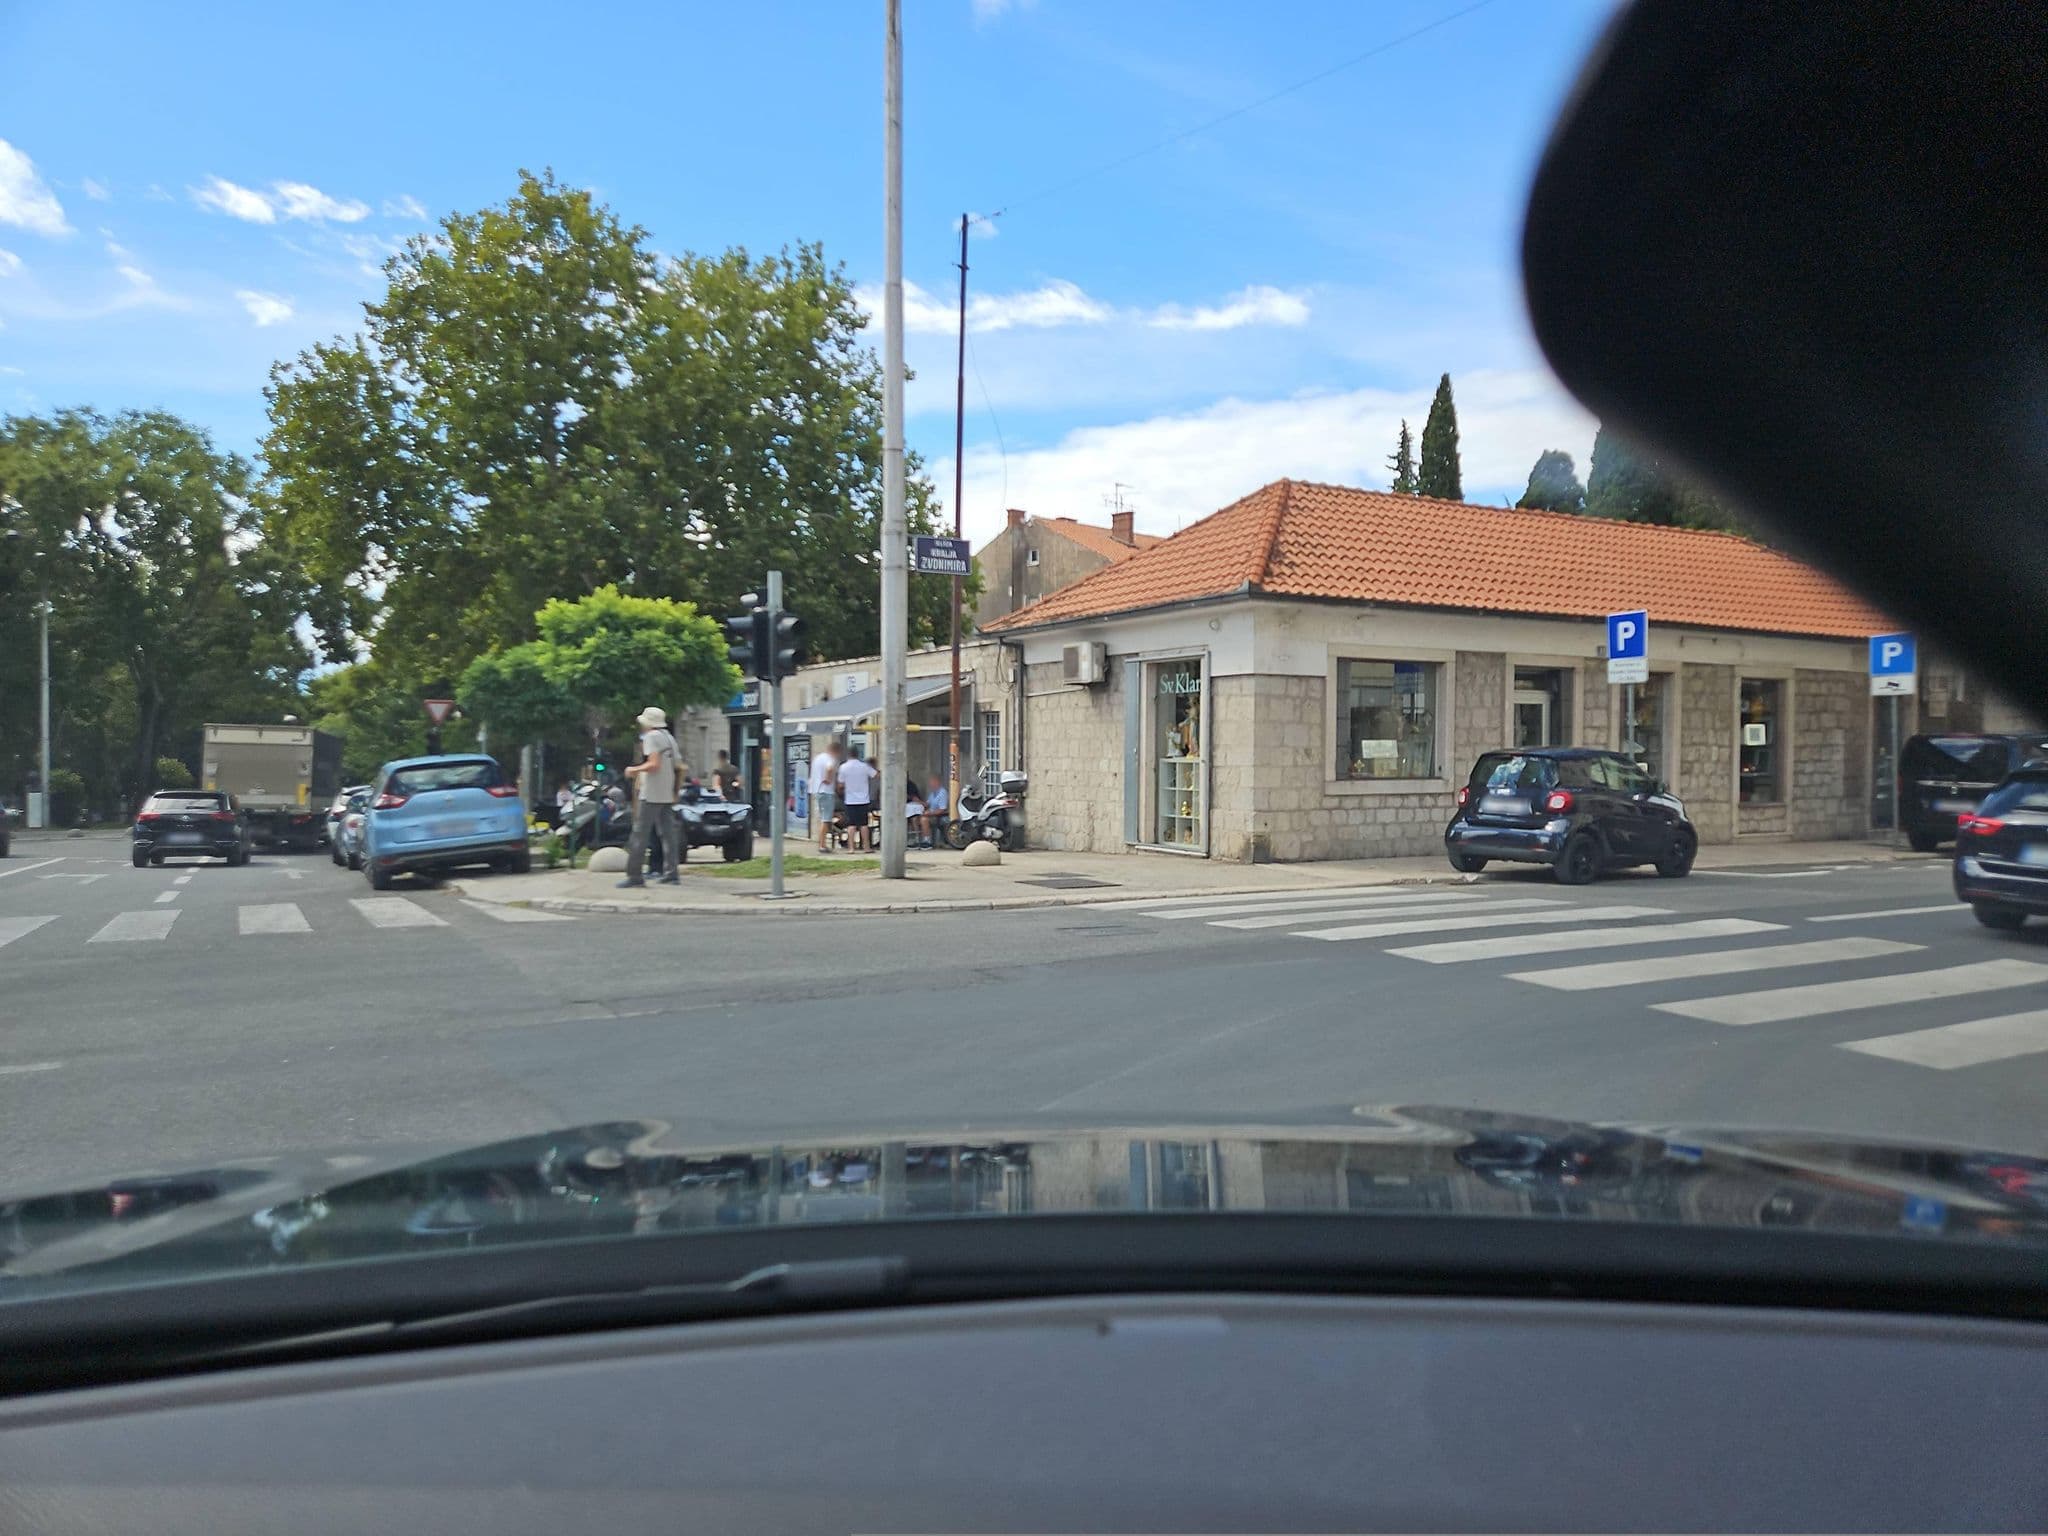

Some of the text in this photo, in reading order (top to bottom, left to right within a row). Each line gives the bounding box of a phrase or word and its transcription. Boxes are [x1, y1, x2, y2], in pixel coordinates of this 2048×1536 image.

[920, 556, 967, 572] ZVONIMIRA
[1617, 621, 1636, 651] P
[1882, 642, 1903, 668] P
